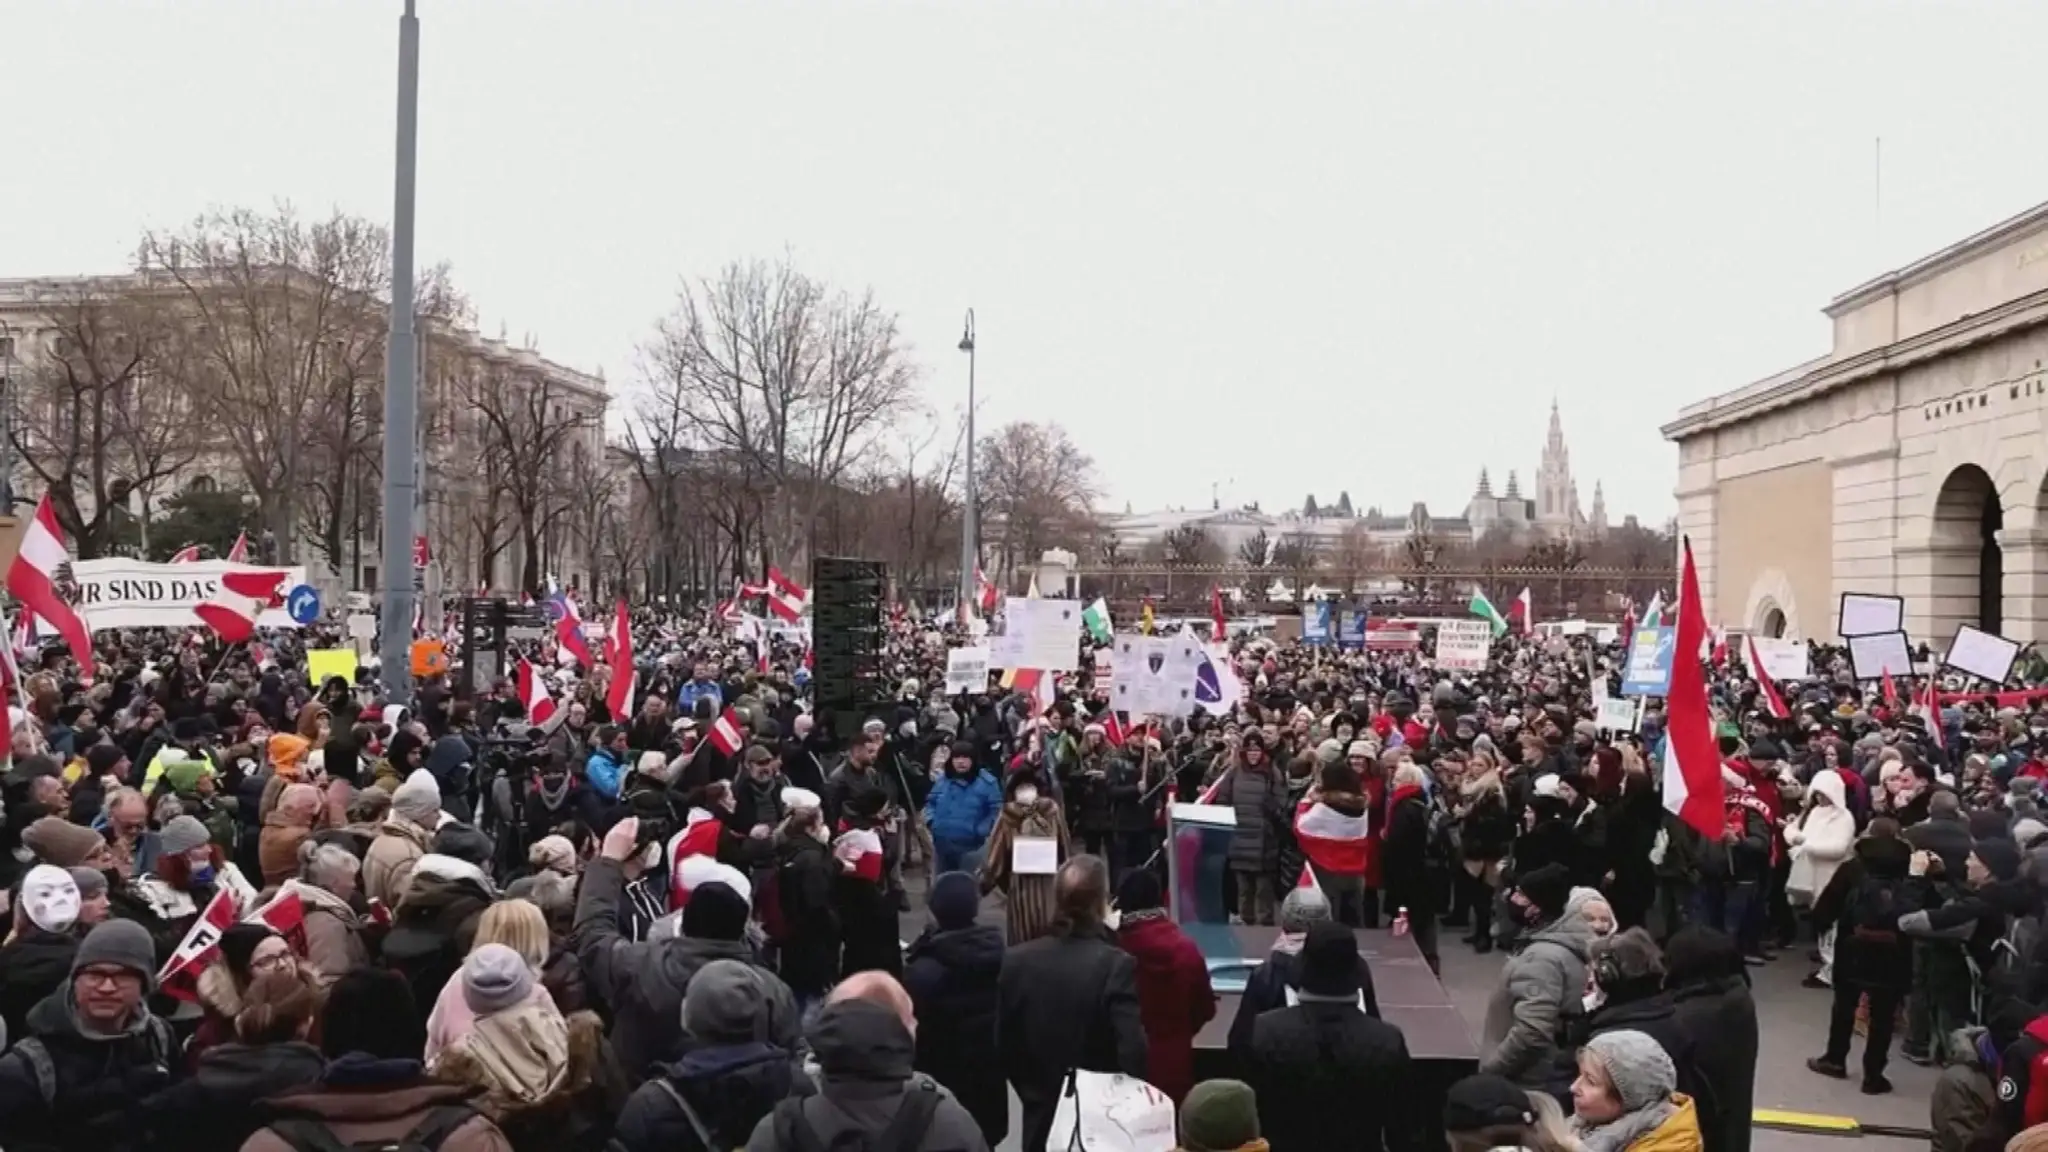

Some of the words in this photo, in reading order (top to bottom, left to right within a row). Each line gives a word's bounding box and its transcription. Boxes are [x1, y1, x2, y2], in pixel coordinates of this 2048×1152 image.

[77, 582, 102, 605] IR
[108, 580, 164, 601] SIND
[172, 580, 218, 601] DAS
